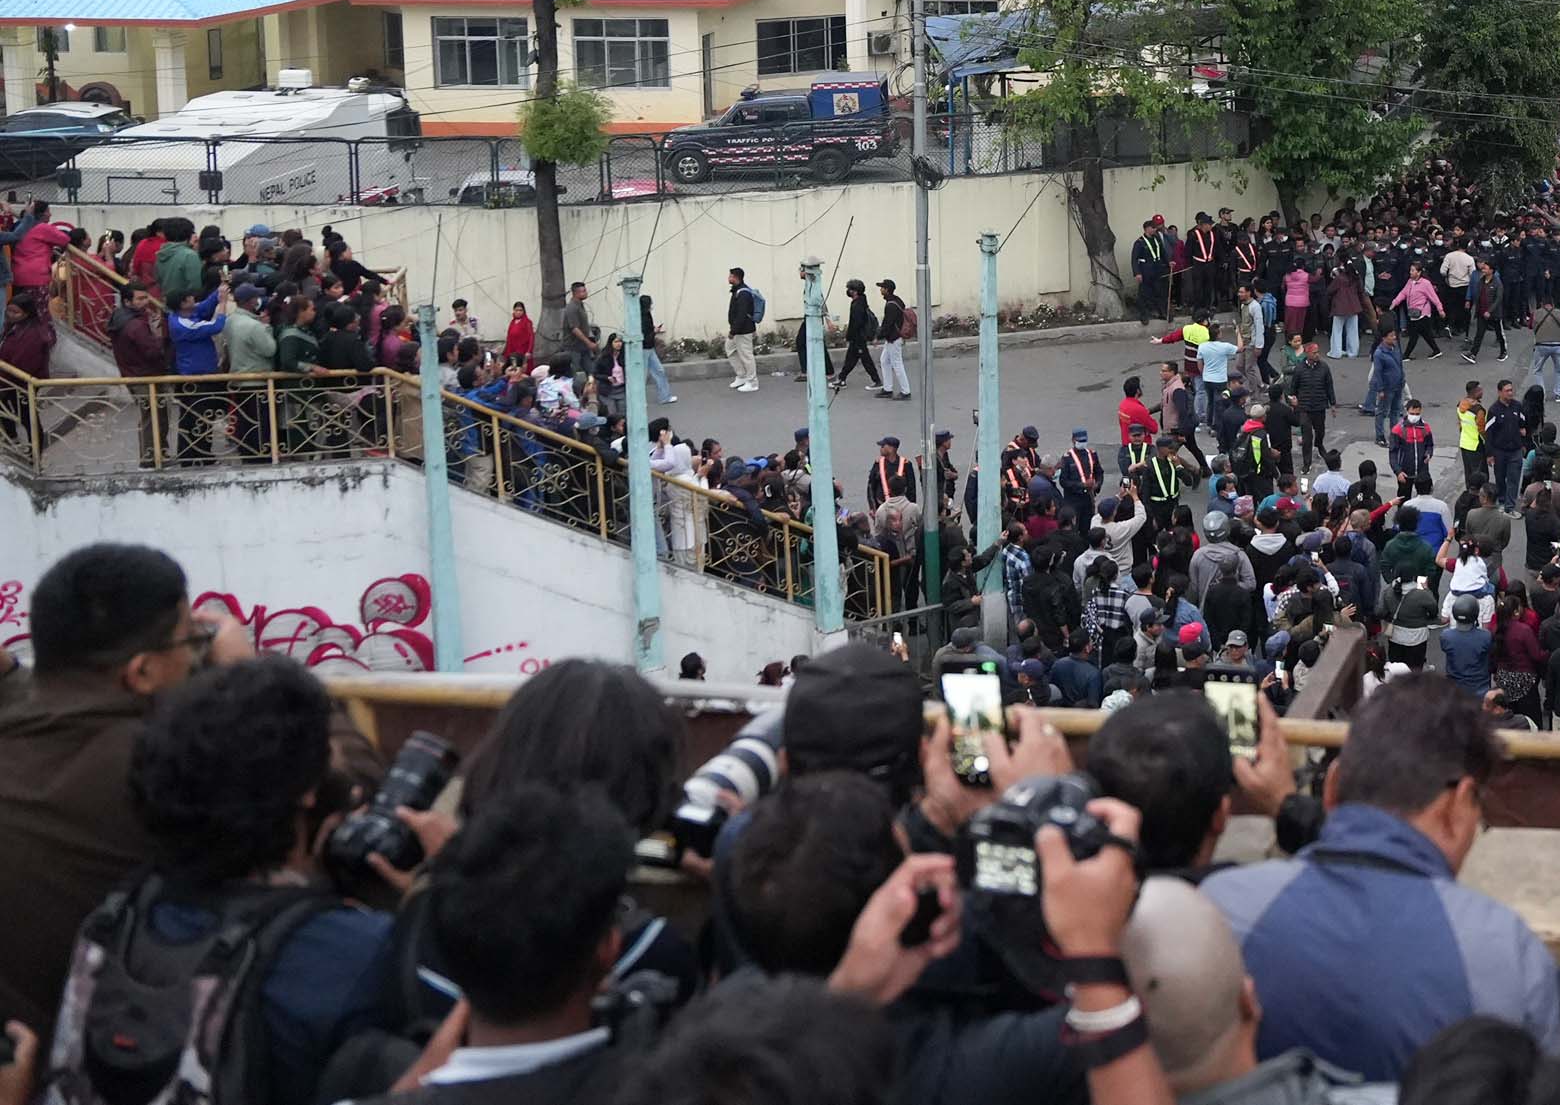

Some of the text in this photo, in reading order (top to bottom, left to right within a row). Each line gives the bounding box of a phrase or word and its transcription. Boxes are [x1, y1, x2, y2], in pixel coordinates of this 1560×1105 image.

[856, 141, 878, 152] 103
[260, 170, 316, 201] NEPAL POLICE
